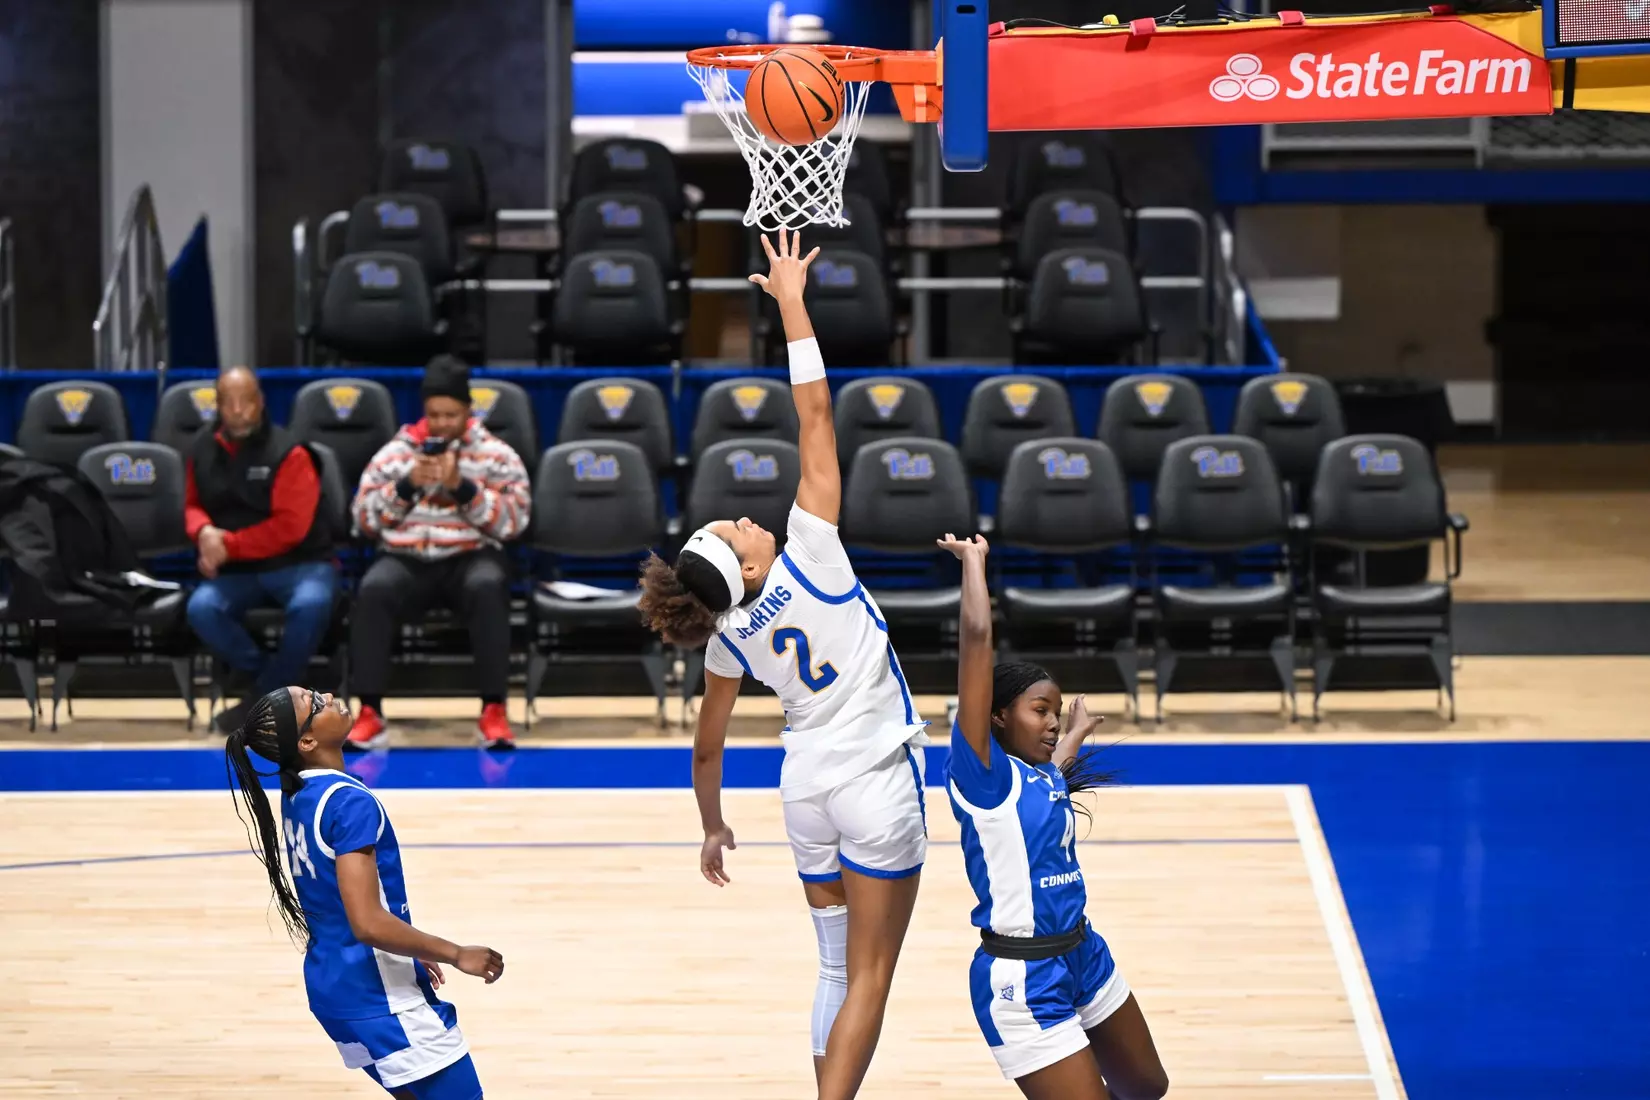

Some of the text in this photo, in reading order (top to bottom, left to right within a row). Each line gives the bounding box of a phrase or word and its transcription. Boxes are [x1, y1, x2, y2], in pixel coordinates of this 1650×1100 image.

[736, 585, 792, 640] JENKINS
[770, 624, 840, 695] 2
[1060, 807, 1075, 863] 4
